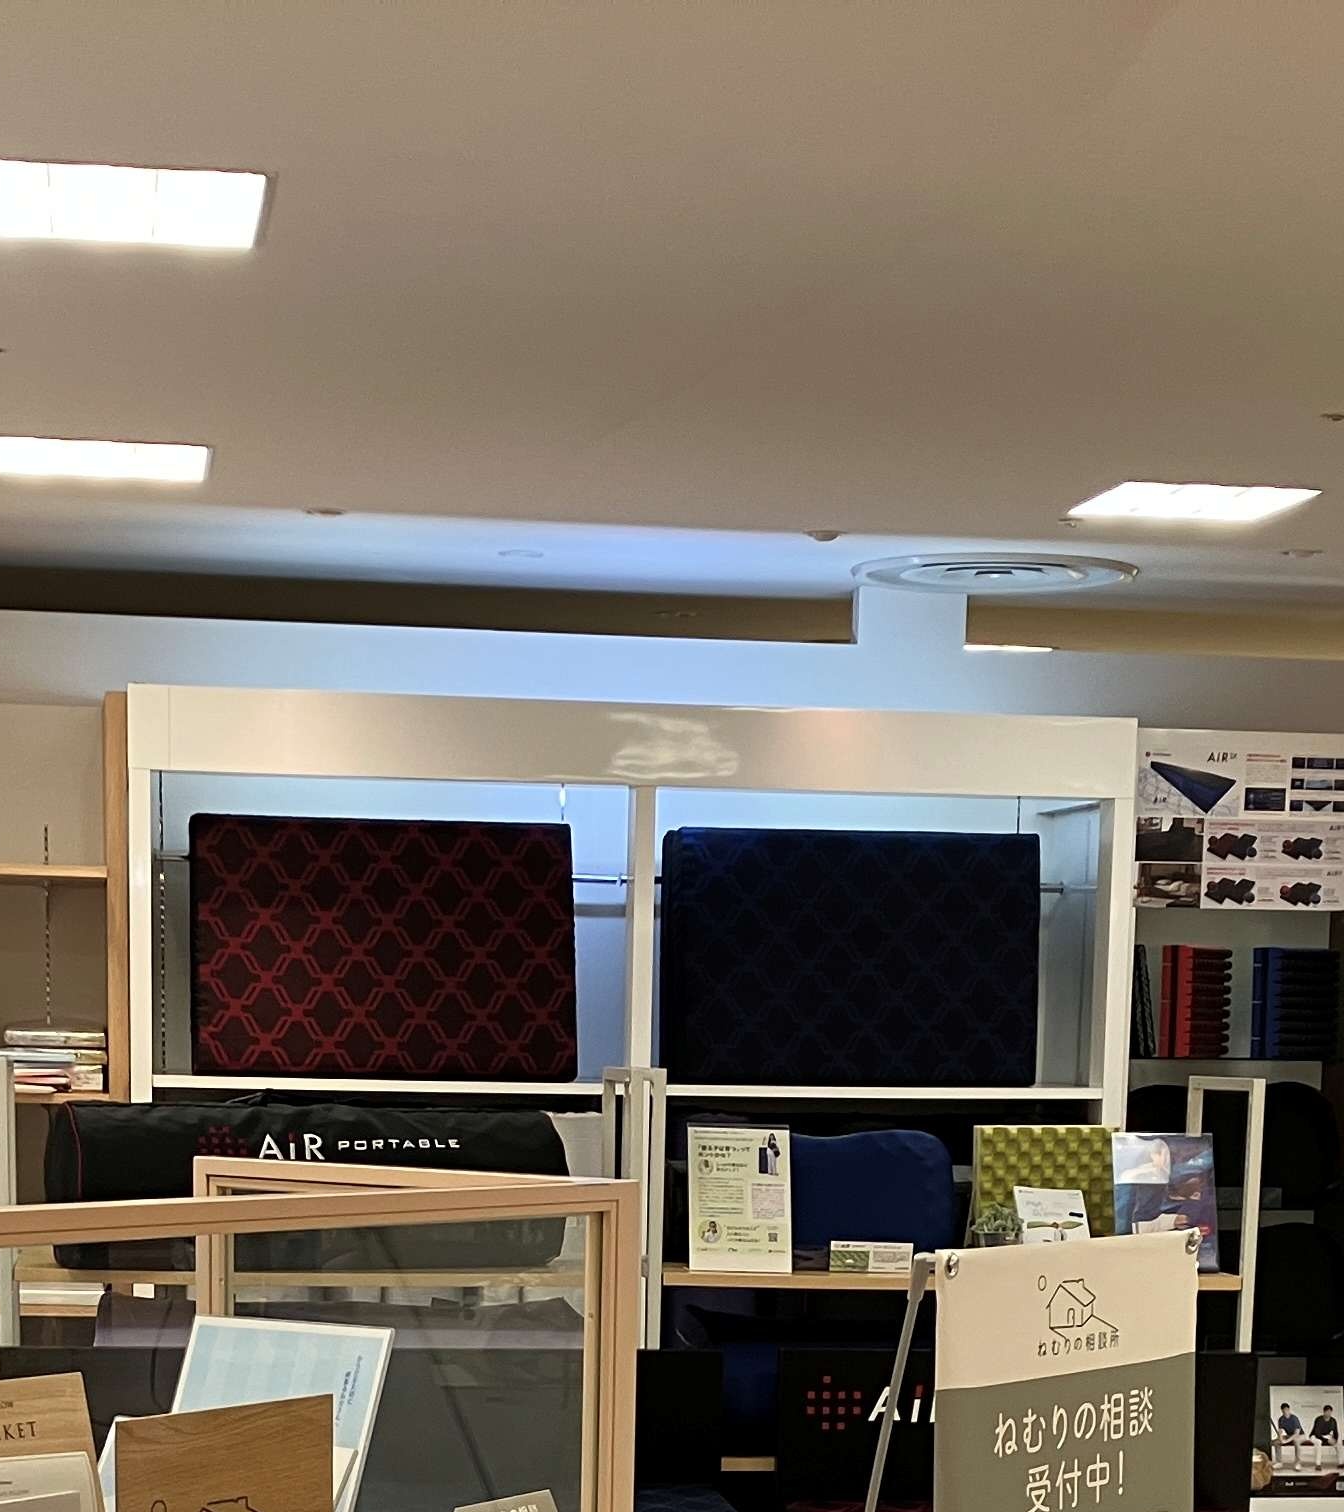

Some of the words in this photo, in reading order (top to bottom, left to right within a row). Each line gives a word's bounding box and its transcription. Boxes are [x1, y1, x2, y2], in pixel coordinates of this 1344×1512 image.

[337, 1138, 461, 1151] PORTABLE
[1037, 1330, 1119, 1357] ねむりの相談所
[868, 1384, 936, 1423] Ai
[994, 1386, 1154, 1458] ねむりの相談
